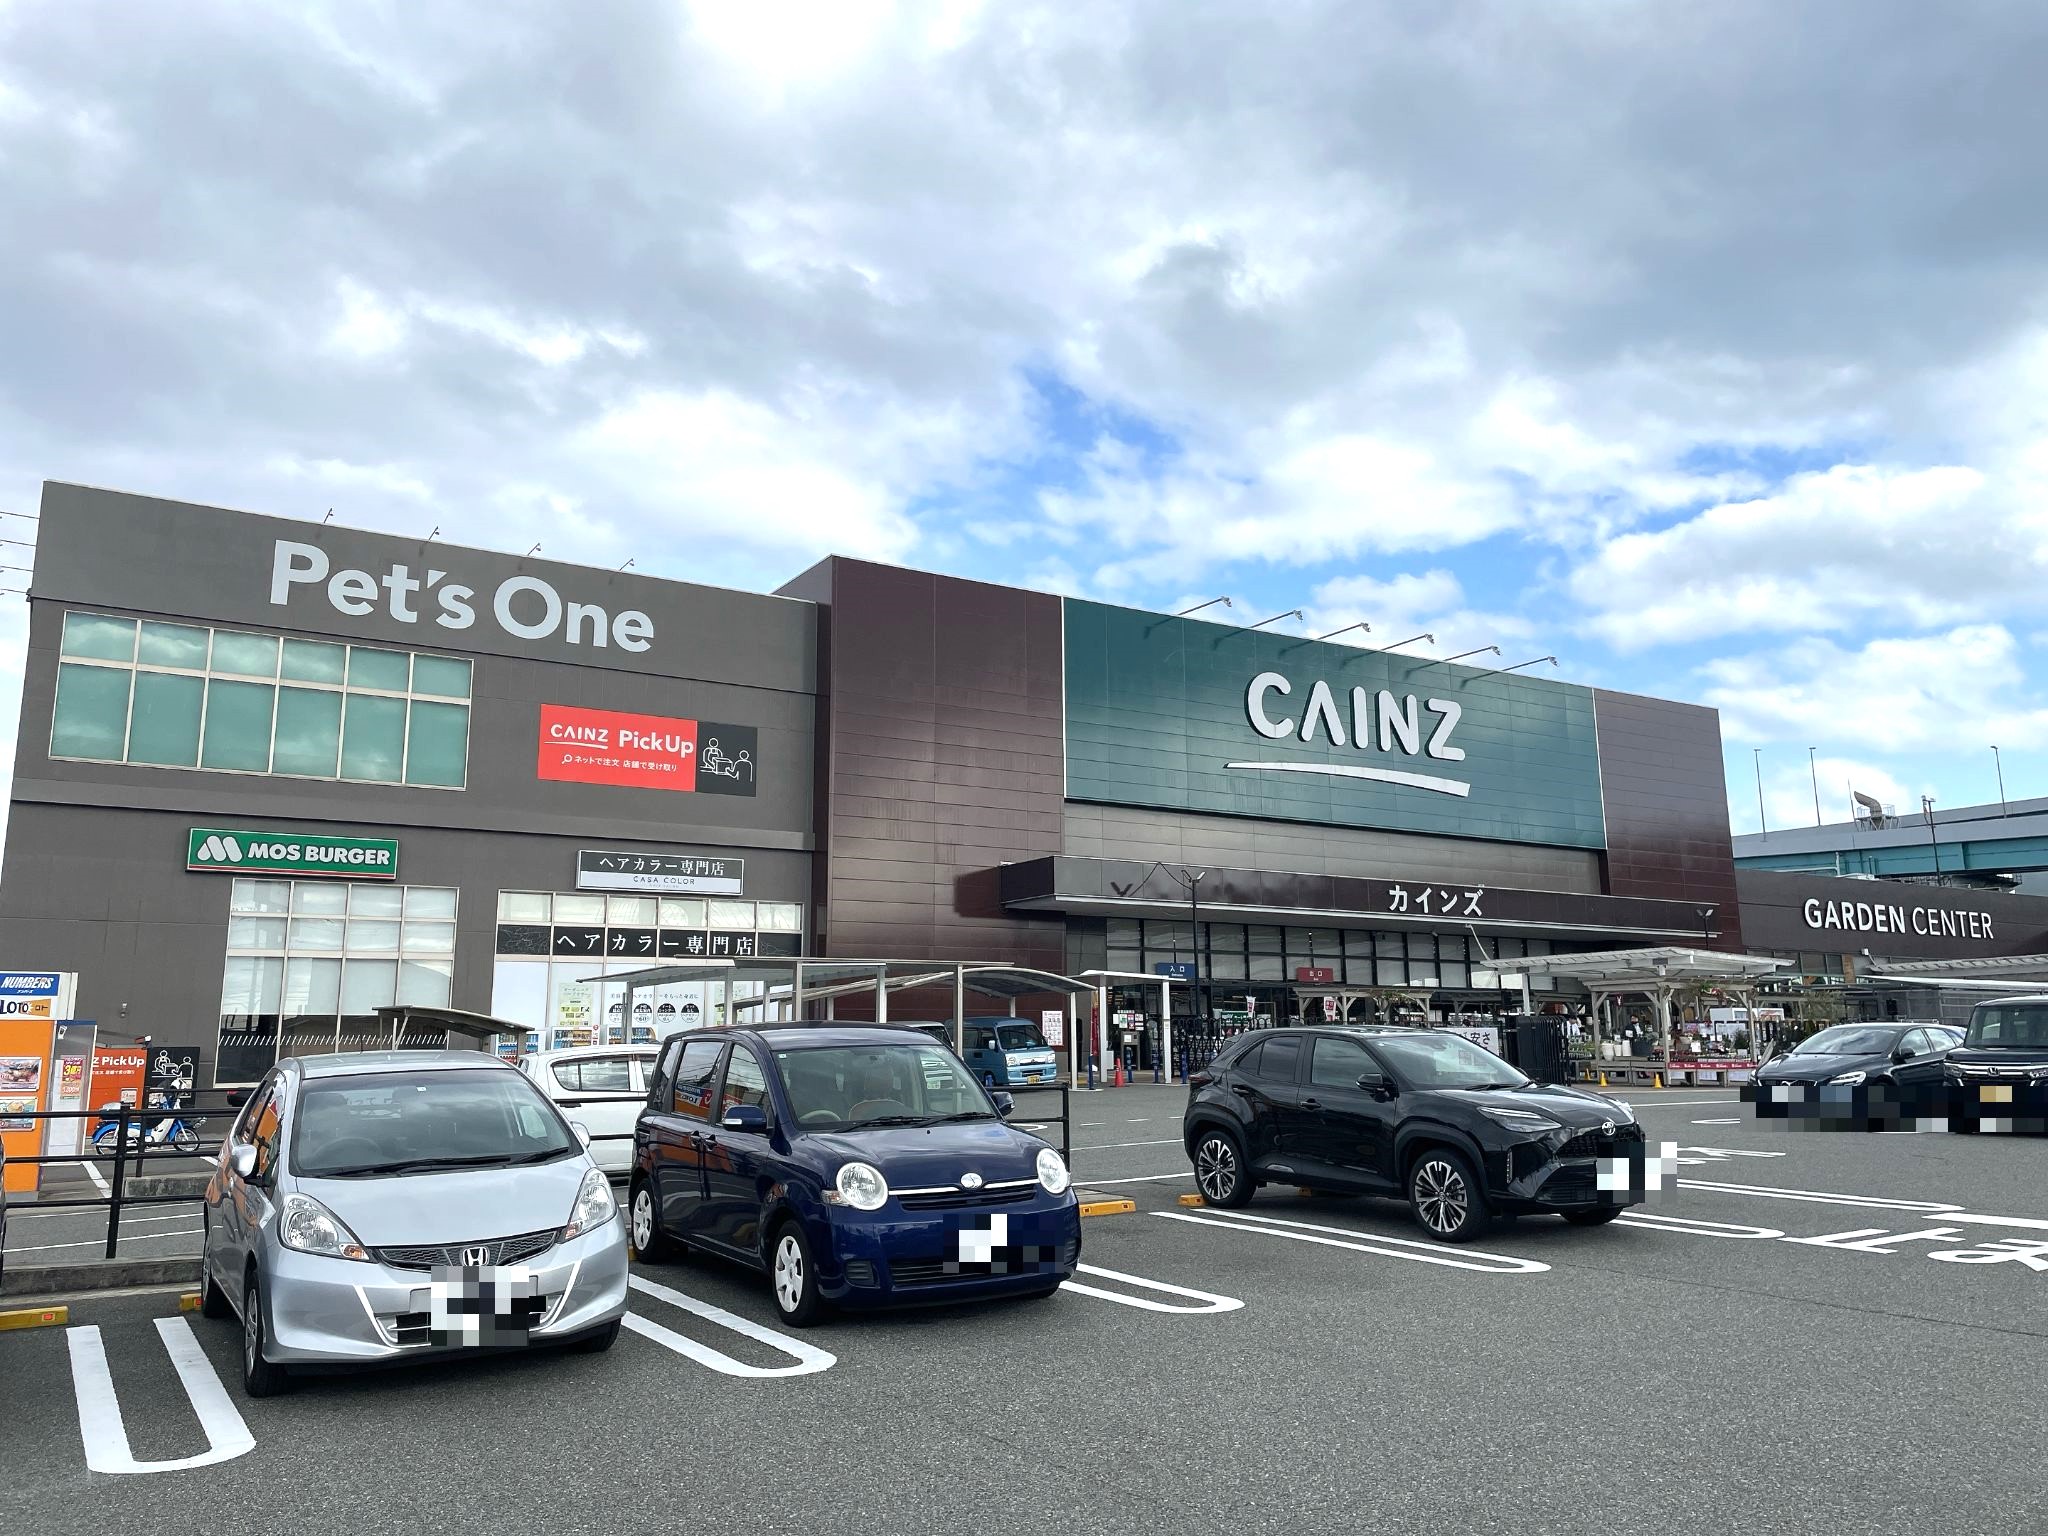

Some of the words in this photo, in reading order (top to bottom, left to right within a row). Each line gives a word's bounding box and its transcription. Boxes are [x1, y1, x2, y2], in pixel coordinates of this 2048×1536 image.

[270, 539, 476, 630] Pet's
[493, 575, 655, 653] One
[1245, 671, 1466, 761] CAINZ
[550, 724, 609, 742] CAINZ
[574, 755, 620, 767] ネットで注文
[248, 842, 301, 861] MOS
[305, 846, 391, 865] BURGER
[599, 857, 725, 876] ヘアカラー専門店
[663, 877, 695, 885] COLOR
[1388, 884, 1484, 917] カインズ
[1803, 898, 1906, 934] GARDEN
[1912, 906, 1994, 939] CENTER
[556, 933, 753, 956] ヘアカラー専門店
[1169, 965, 1185, 973] 入口
[1, 976, 54, 989] NUMBERS
[0, 1000, 29, 1015] LOTO
